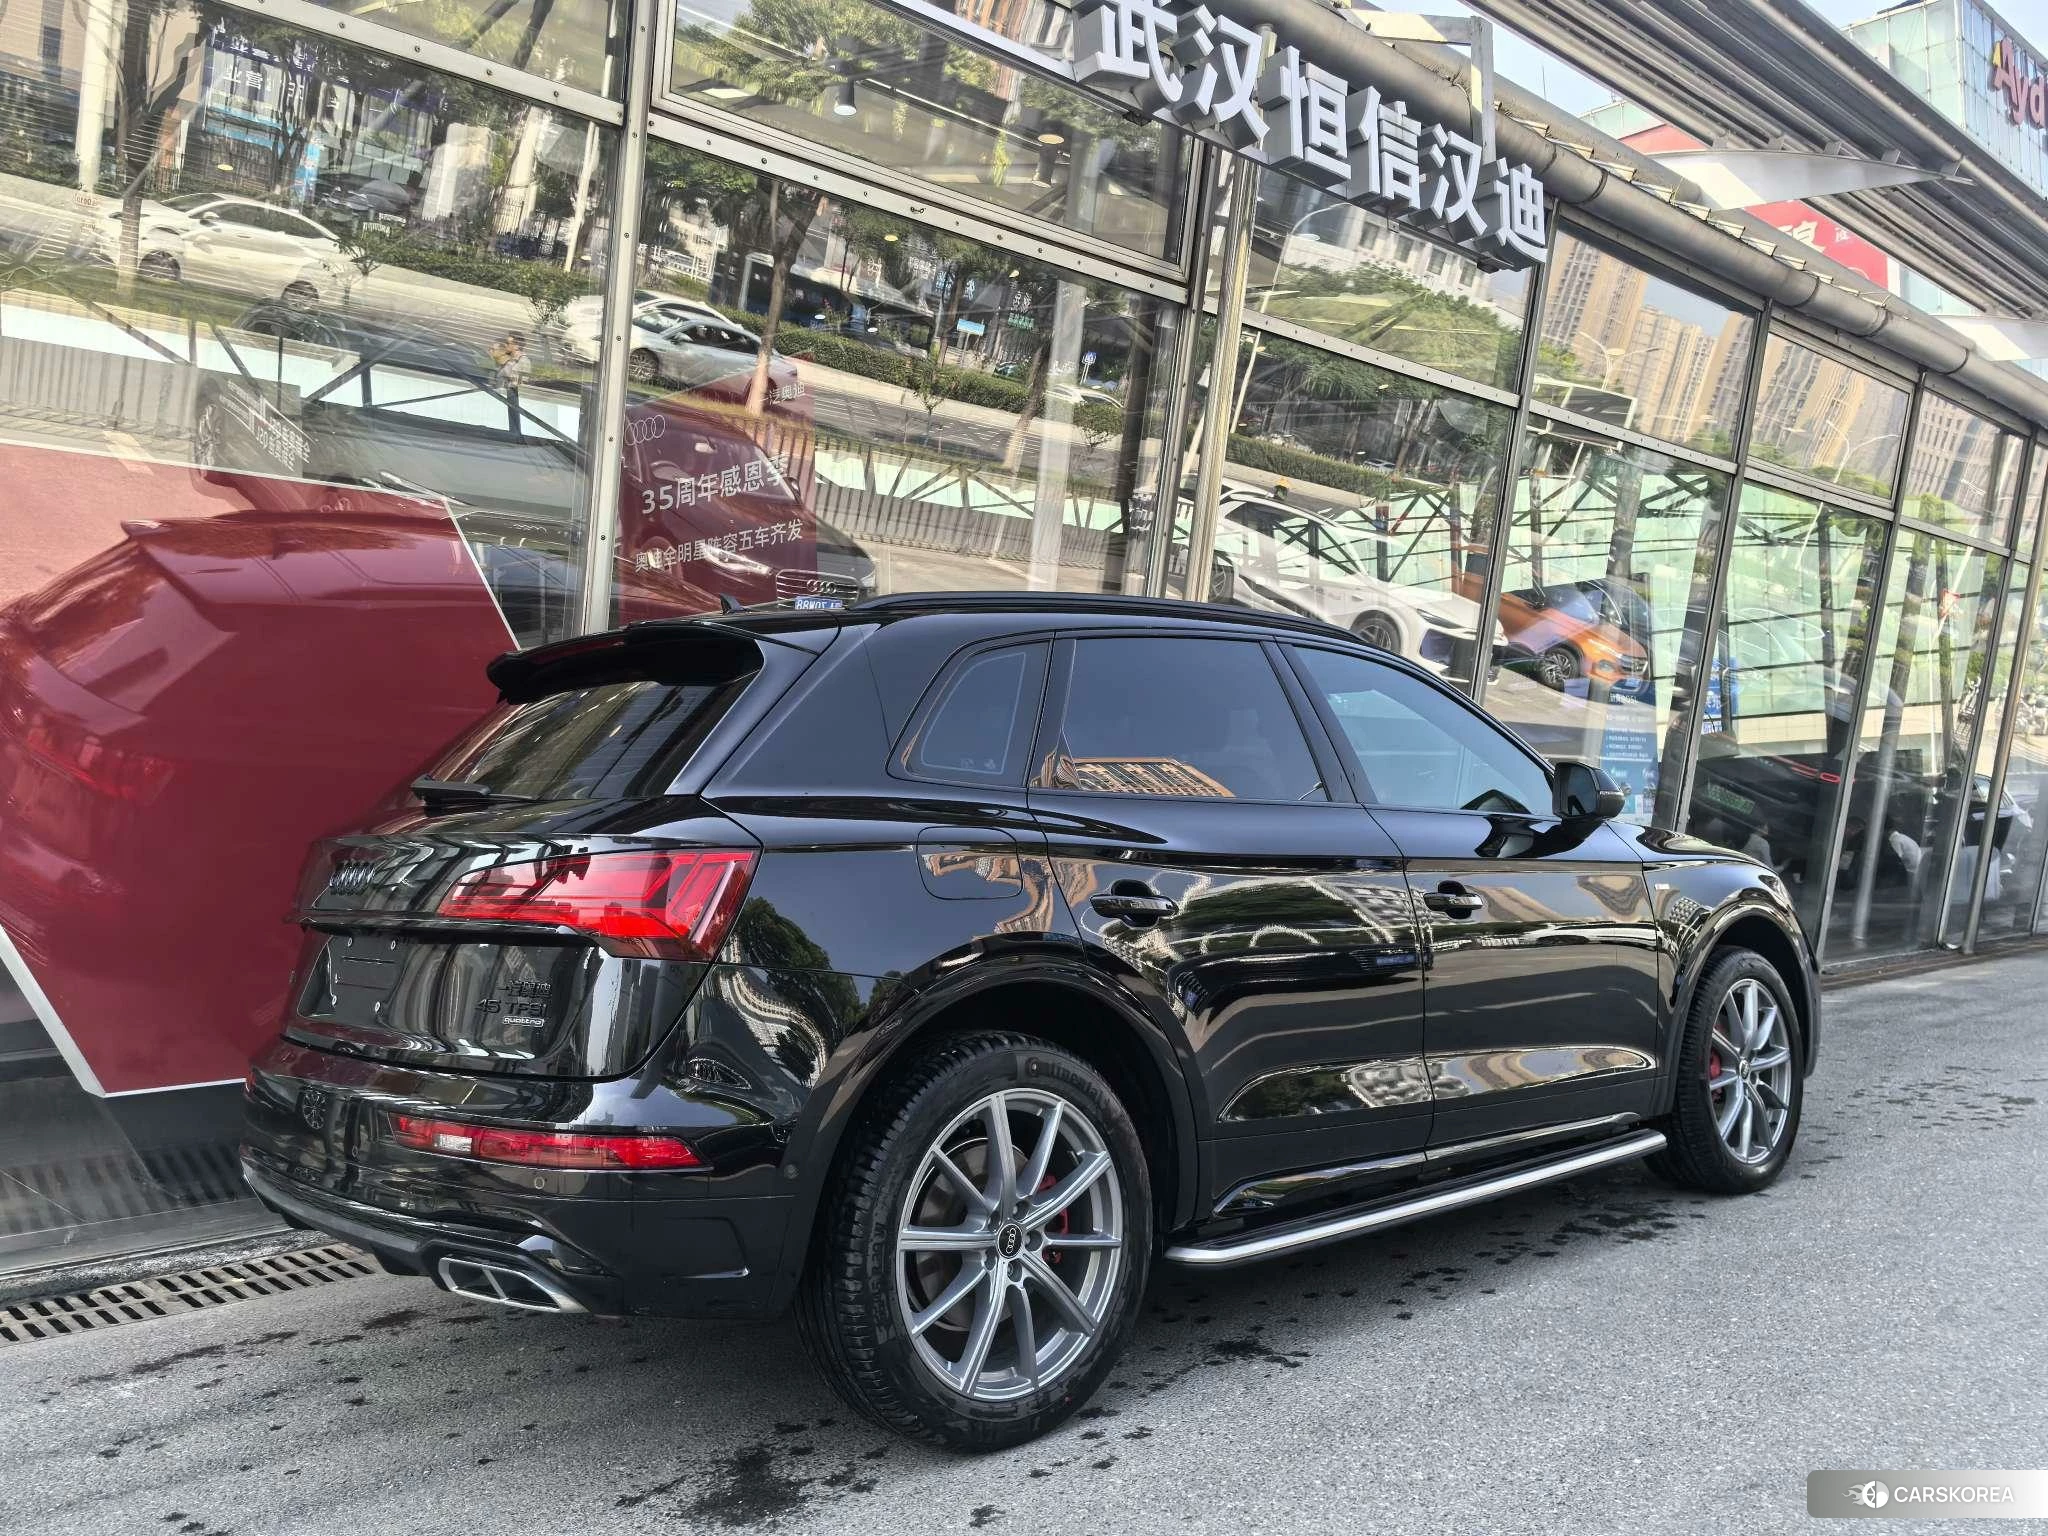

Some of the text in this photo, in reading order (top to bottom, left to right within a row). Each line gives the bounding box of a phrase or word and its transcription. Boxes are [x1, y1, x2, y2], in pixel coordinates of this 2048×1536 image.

[1096, 0, 1547, 264] 武汉恒信汉迪
[641, 454, 789, 515] 35周年感恩季
[475, 998, 501, 1014] 45
[503, 1016, 544, 1028] quattro
